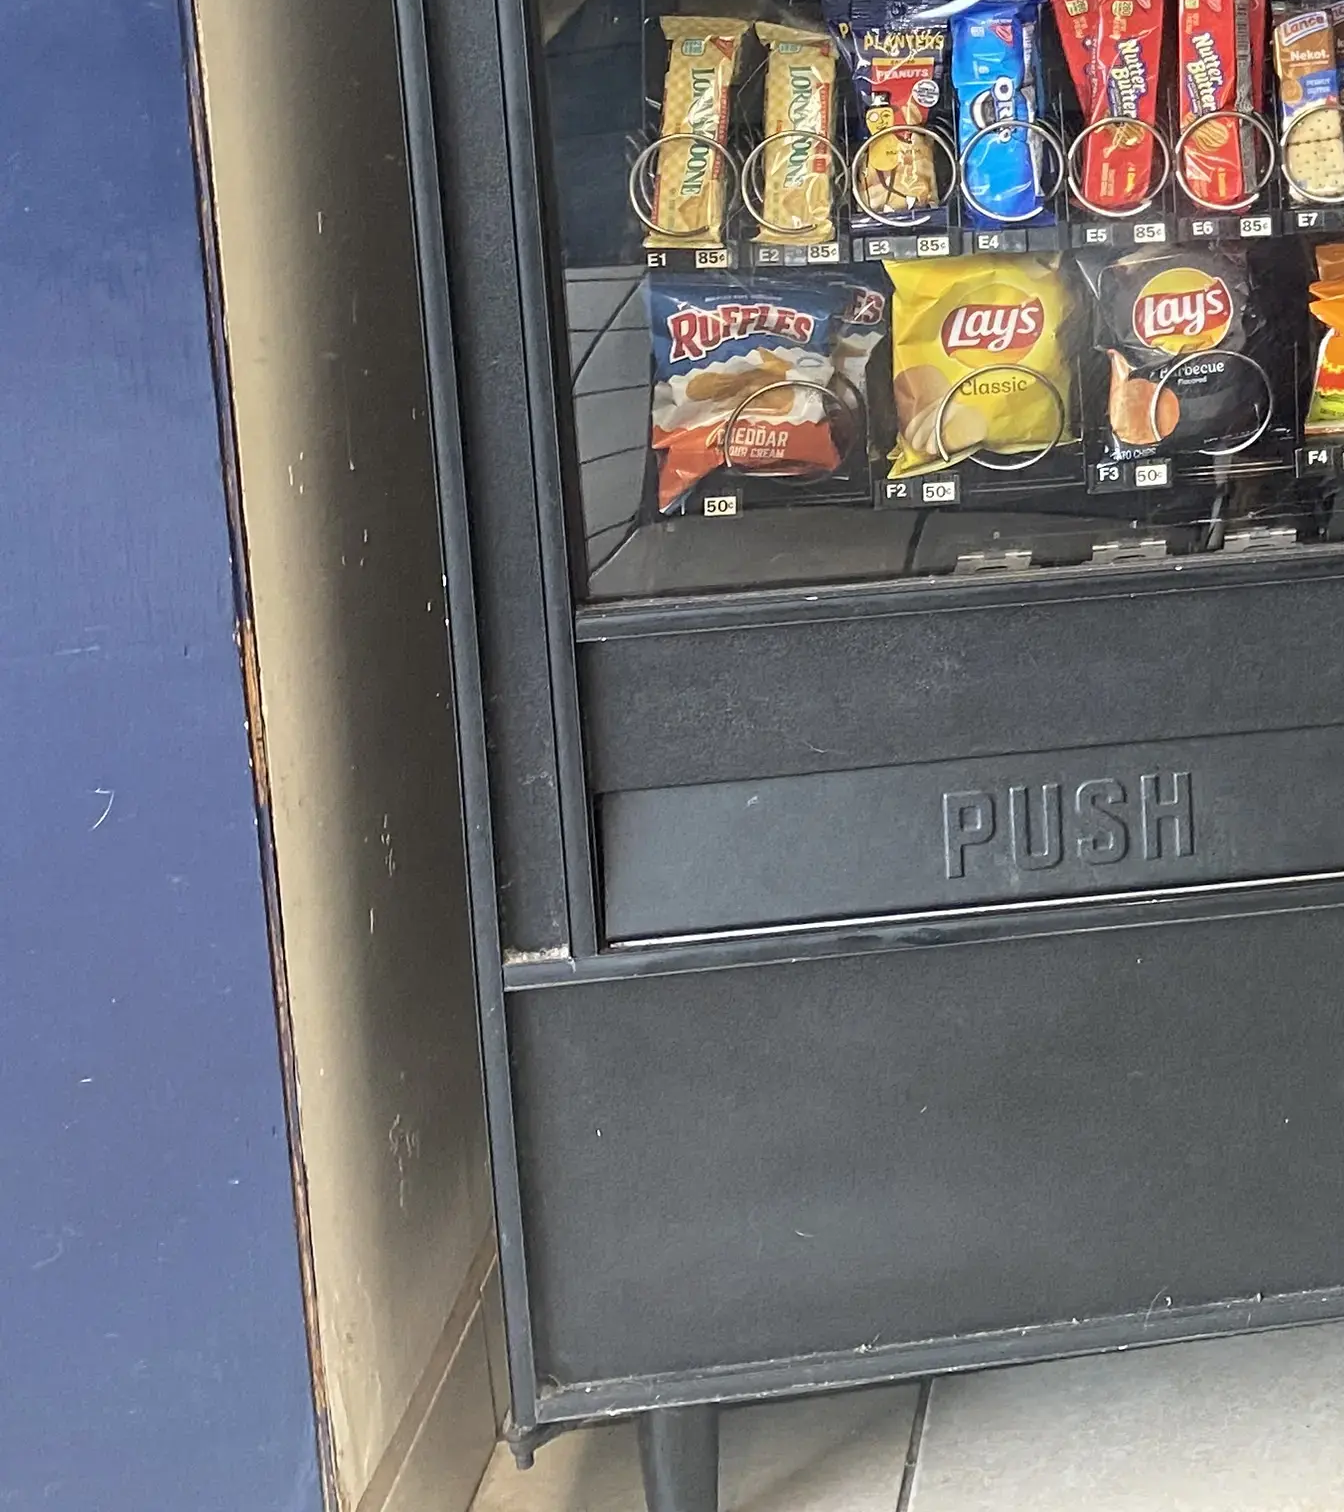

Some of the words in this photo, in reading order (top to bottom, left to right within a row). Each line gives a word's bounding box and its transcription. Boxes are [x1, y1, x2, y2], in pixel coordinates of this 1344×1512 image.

[1283, 15, 1324, 37] Lance
[864, 31, 944, 51] PLANTERS
[1192, 33, 1223, 86] Nutter
[1290, 48, 1326, 61] Nekot
[878, 68, 928, 80] PEANUTS
[1119, 39, 1146, 94] Nutter
[1187, 61, 1216, 112] Butter
[1298, 213, 1318, 227] E7
[1086, 228, 1107, 243] E5
[1193, 222, 1213, 236] E6
[869, 240, 890, 254] E3
[978, 235, 998, 249] E4
[647, 253, 666, 267] E1
[759, 248, 779, 262] E2
[1144, 288, 1224, 337] Lay's
[670, 304, 813, 360] RUFFLES
[947, 302, 1038, 350] Lay's
[959, 376, 1027, 397] Classic
[1308, 451, 1327, 464] F4
[1099, 467, 1119, 481] F3
[886, 484, 907, 499] F2
[942, 772, 1196, 880] PUSH
